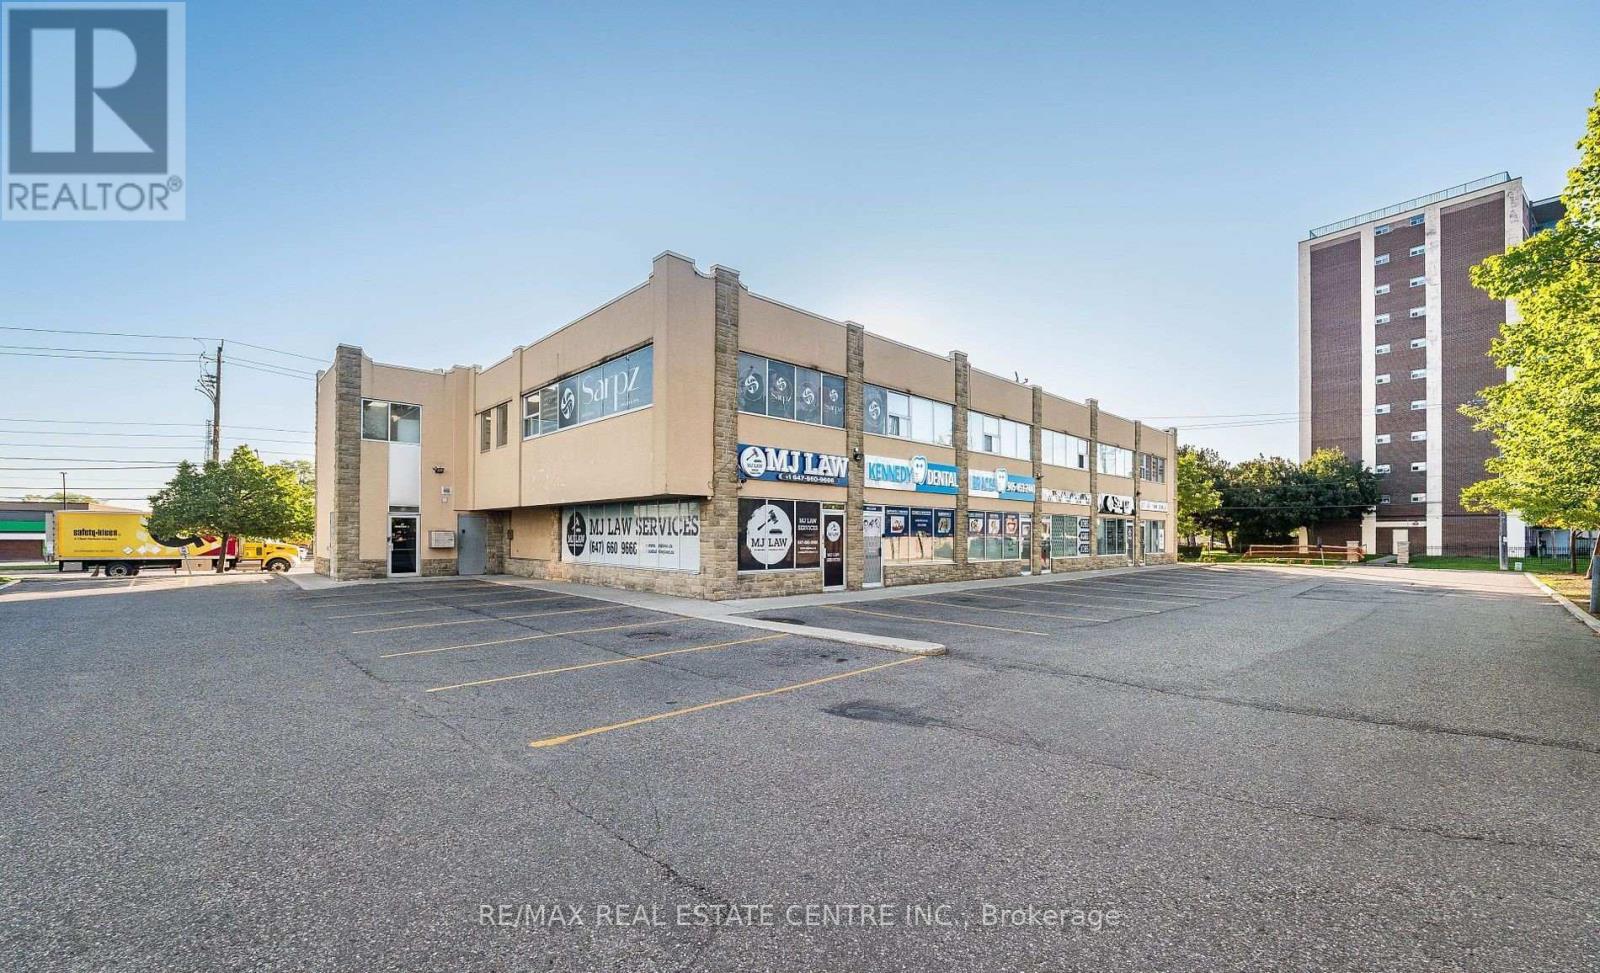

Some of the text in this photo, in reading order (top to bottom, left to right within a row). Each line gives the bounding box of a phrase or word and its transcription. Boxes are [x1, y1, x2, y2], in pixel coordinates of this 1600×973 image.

[765, 448, 849, 478] MJ LAW
[868, 462, 913, 483] KENNEDY
[927, 469, 959, 487] DENTAL
[589, 515, 699, 537] MJ LAW SERVICES
[751, 537, 765, 548] MJ
[768, 537, 788, 548] LAW
